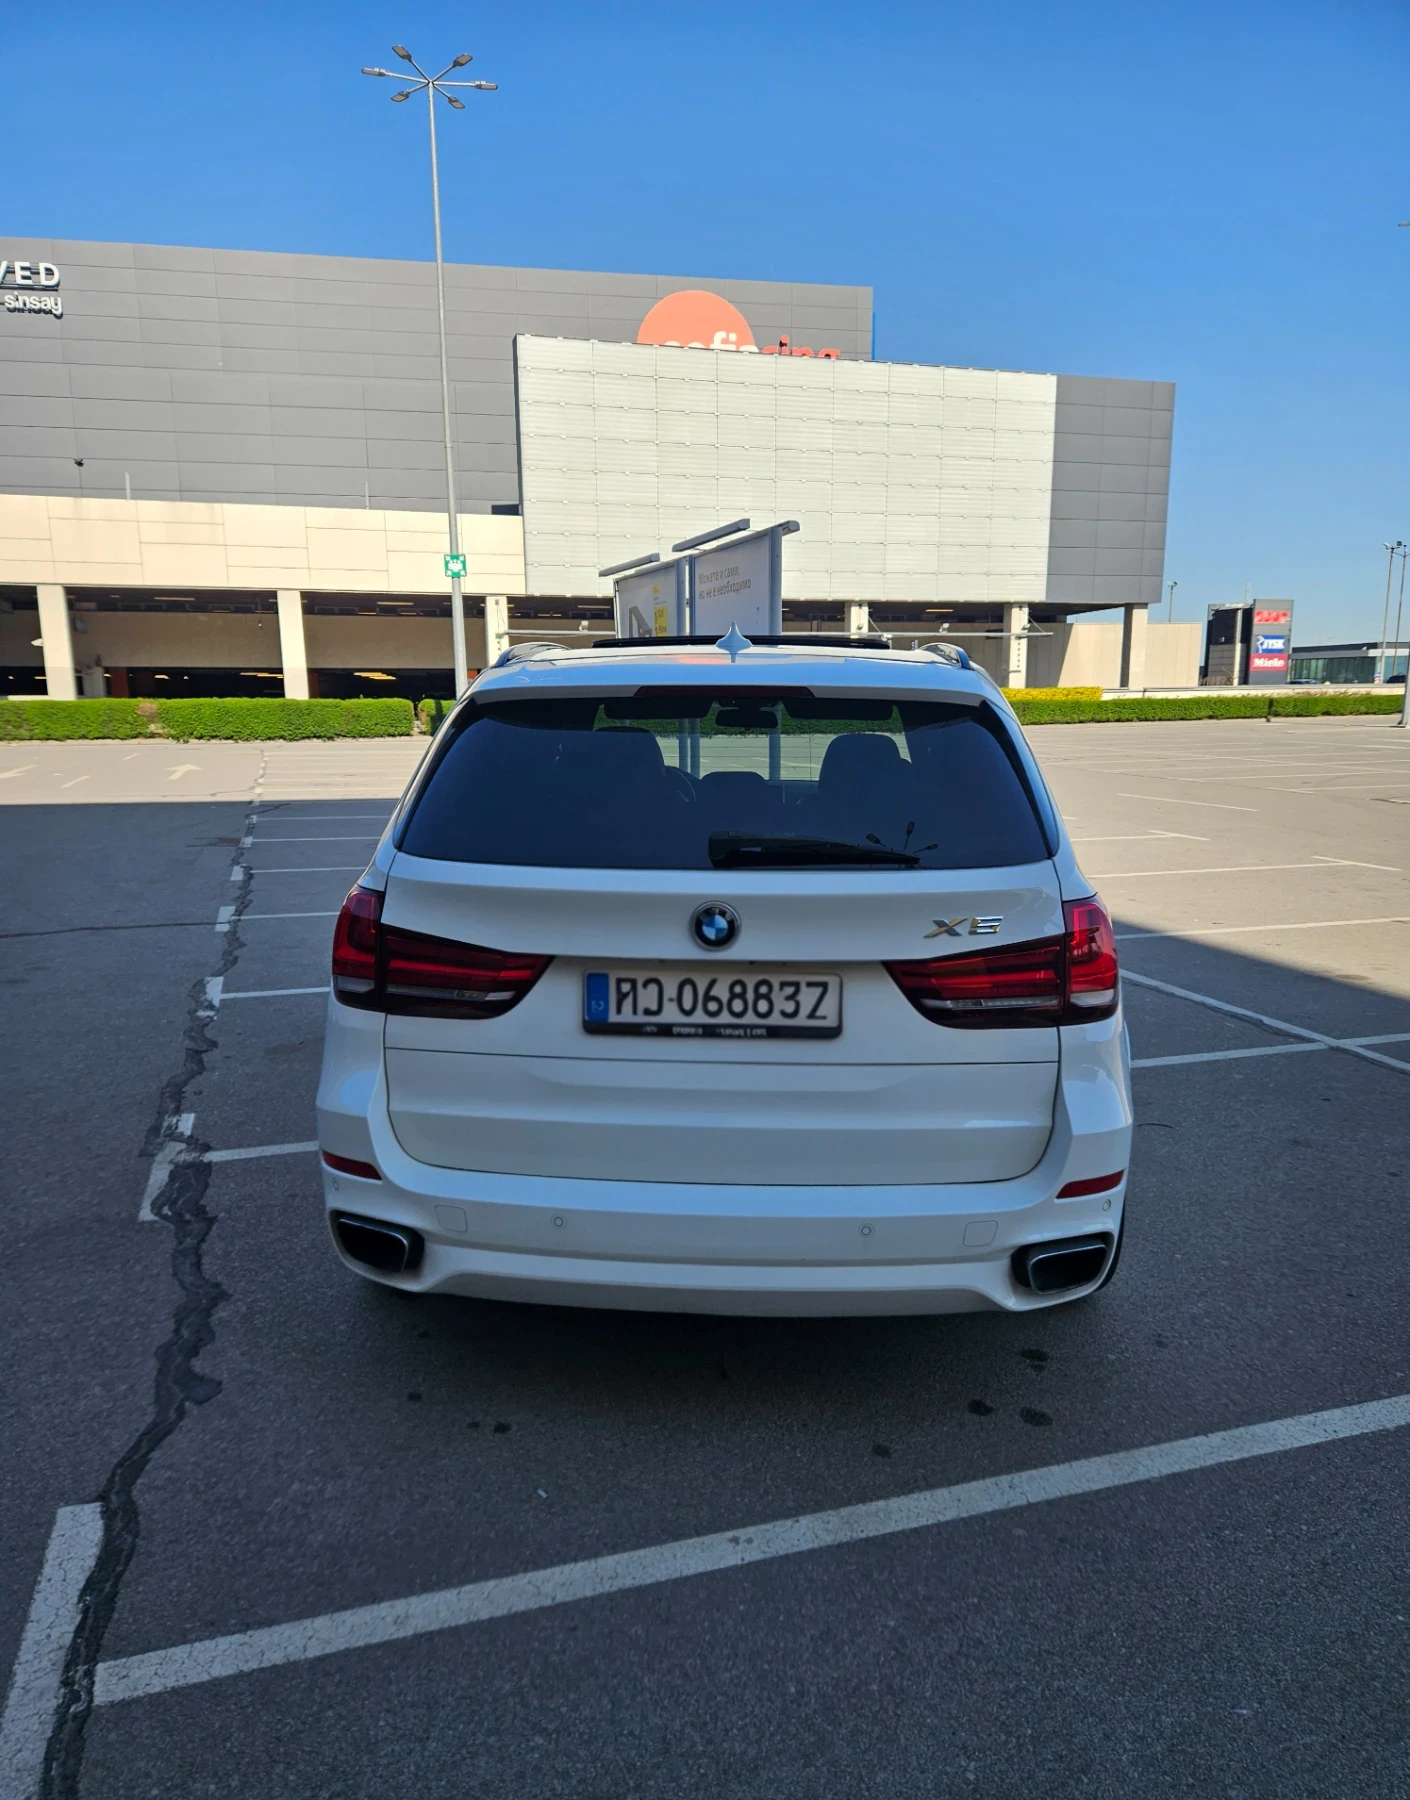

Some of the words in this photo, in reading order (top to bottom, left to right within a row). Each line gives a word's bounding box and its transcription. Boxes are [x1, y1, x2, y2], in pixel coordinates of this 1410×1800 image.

[4, 291, 63, 316] sinsay
[1261, 638, 1285, 649] JYSK
[1253, 657, 1285, 668] Miele
[923, 916, 1004, 939] X5
